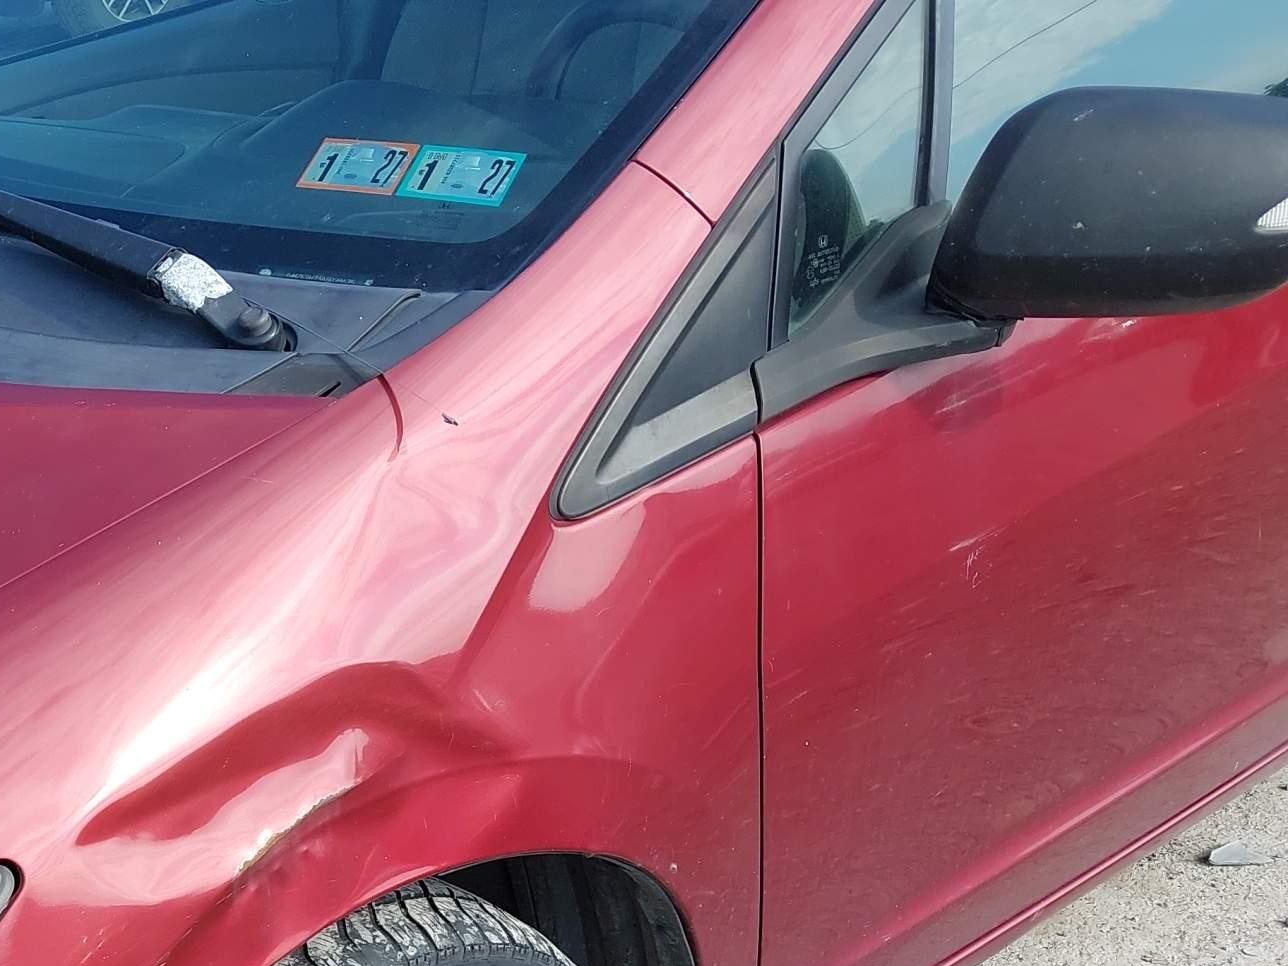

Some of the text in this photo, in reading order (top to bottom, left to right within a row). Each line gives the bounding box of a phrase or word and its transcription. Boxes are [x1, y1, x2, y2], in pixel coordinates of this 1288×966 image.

[318, 152, 340, 182] 1
[370, 149, 409, 185] 27
[416, 159, 439, 191] 1
[477, 159, 517, 196] 27
